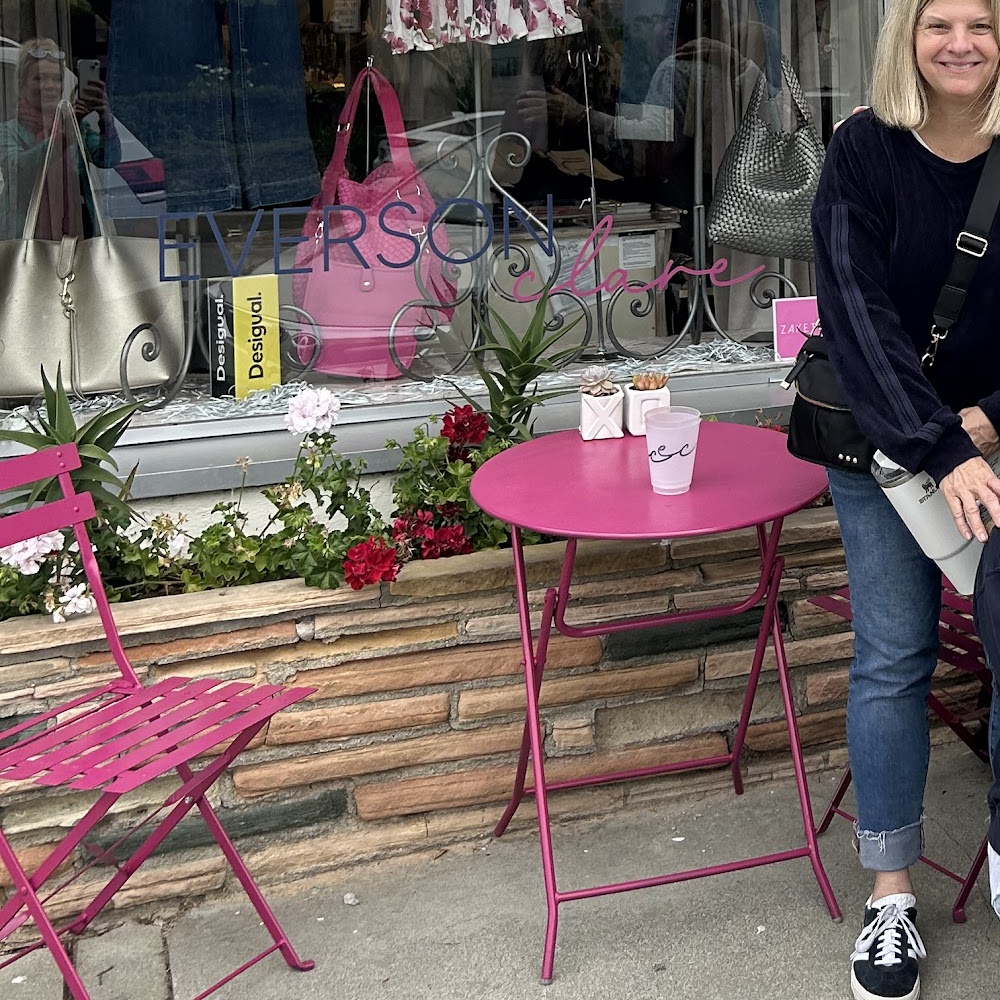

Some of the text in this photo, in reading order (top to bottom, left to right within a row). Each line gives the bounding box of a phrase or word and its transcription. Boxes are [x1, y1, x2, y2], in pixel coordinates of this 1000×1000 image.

[158, 193, 554, 282] EVERSON
[214, 294, 227, 382] Desigual.
[246, 291, 267, 380] Desigual.
